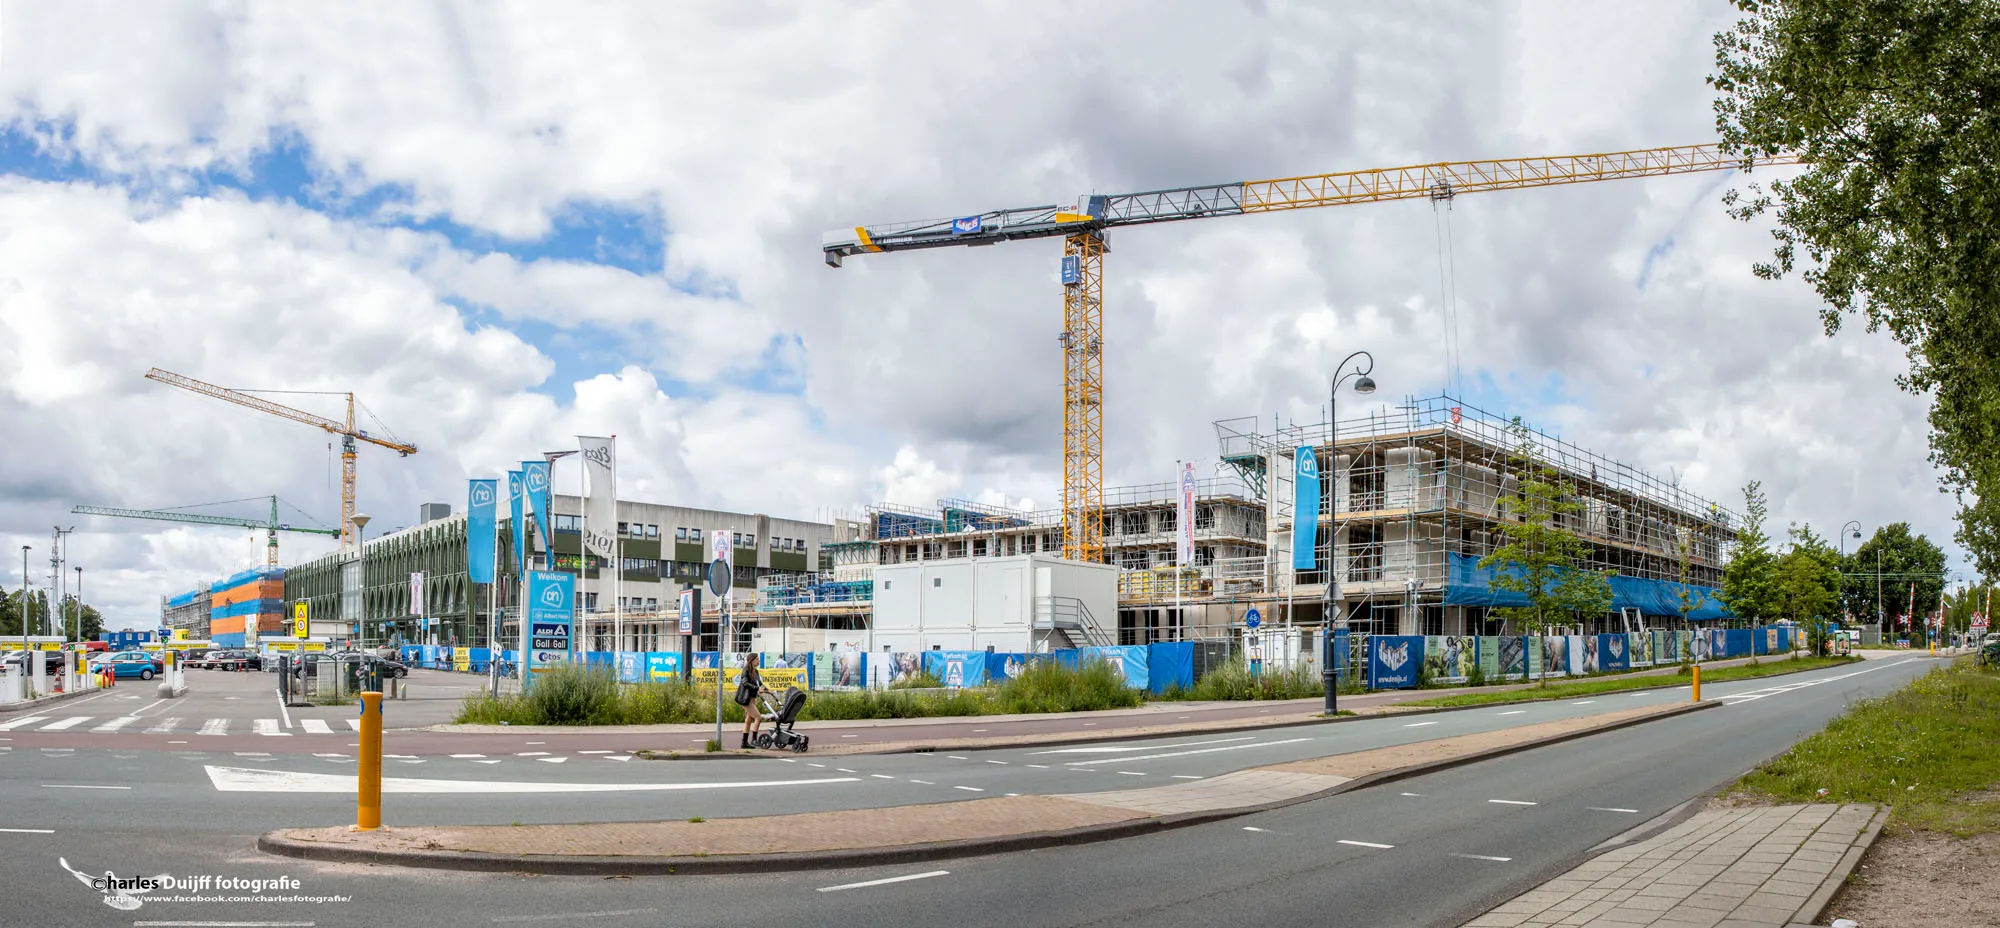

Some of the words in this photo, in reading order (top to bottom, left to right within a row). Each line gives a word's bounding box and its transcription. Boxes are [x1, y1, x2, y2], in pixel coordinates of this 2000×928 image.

[538, 573, 568, 582] Welkom
[535, 639, 550, 648] Gall
[553, 639, 566, 648] Gall
